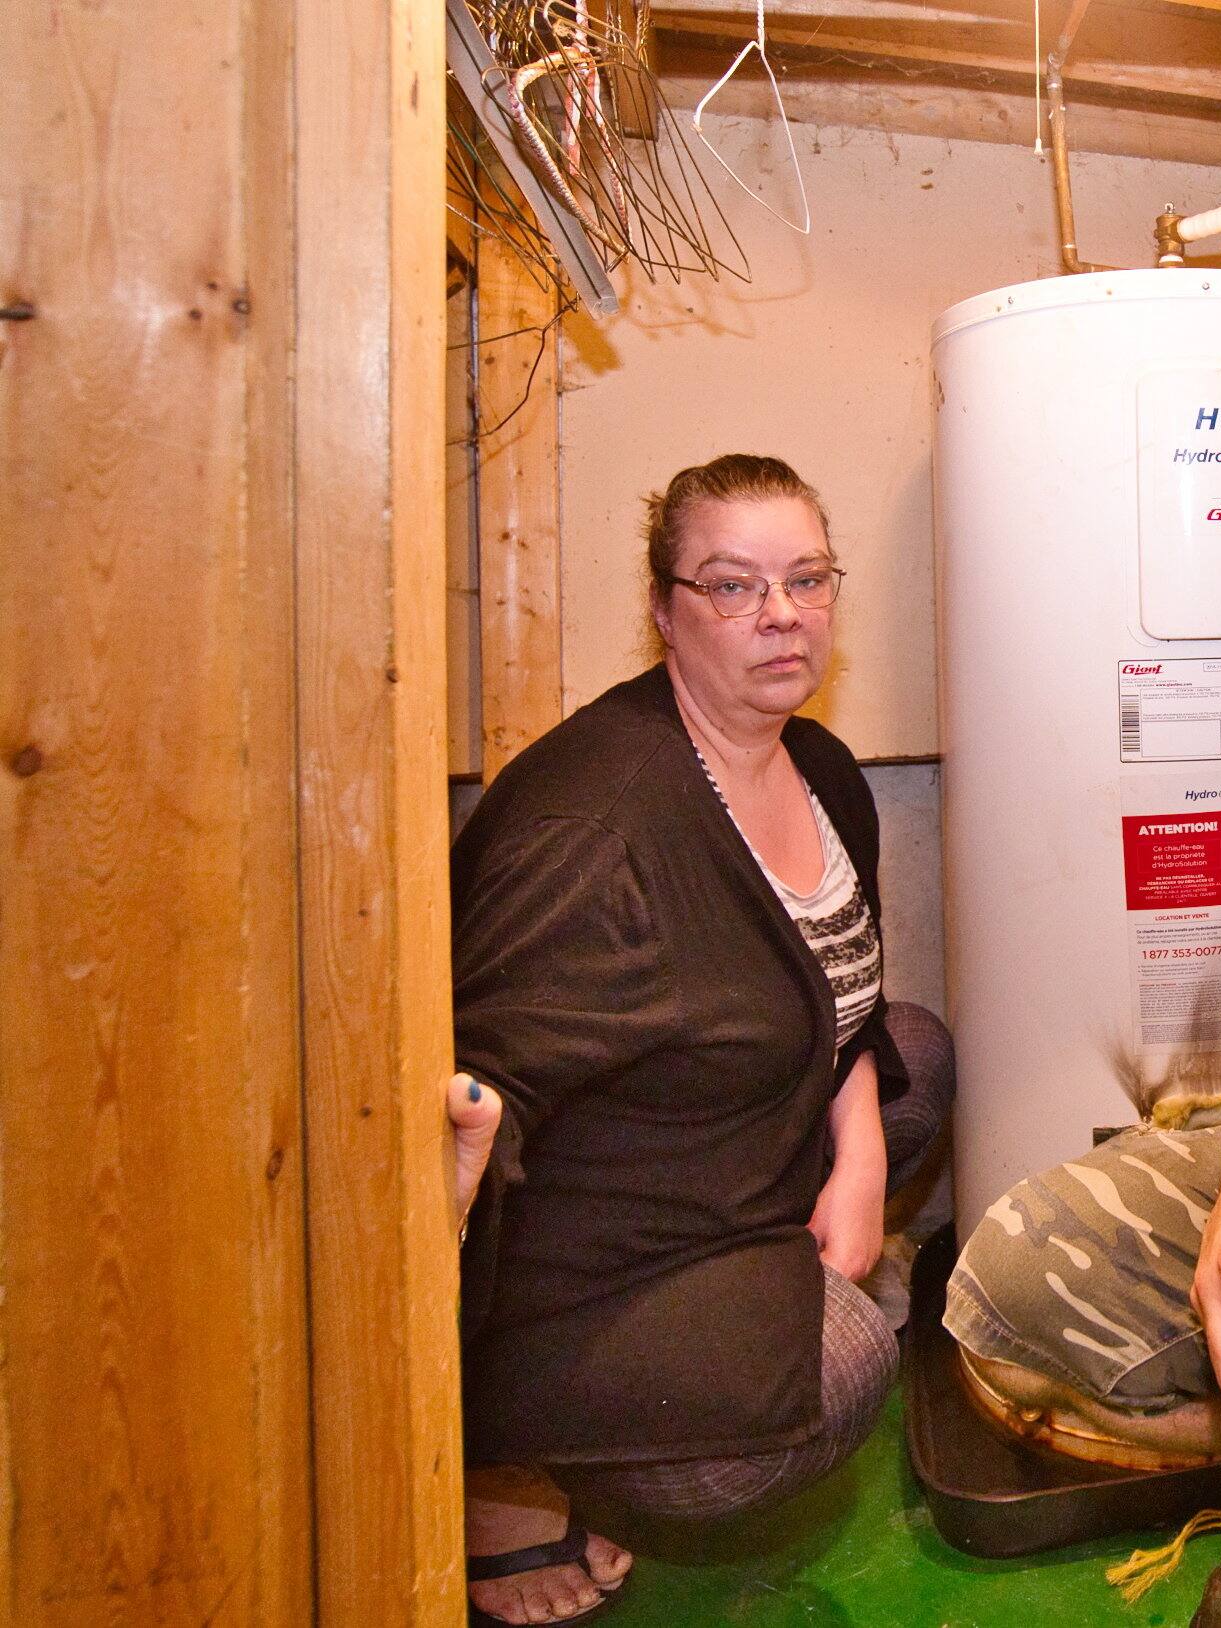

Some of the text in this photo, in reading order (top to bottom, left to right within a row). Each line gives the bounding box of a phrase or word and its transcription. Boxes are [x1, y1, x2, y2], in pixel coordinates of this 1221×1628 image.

[1122, 664, 1163, 676] Giant
[1185, 790, 1218, 801] Hydro
[1138, 821, 1218, 836] ATTENTION!
[1164, 844, 1204, 852] chauffe-eau
[1152, 860, 1208, 869] d'HydroSolution
[1142, 950, 1147, 960] 1
[1149, 950, 1169, 960] 877
